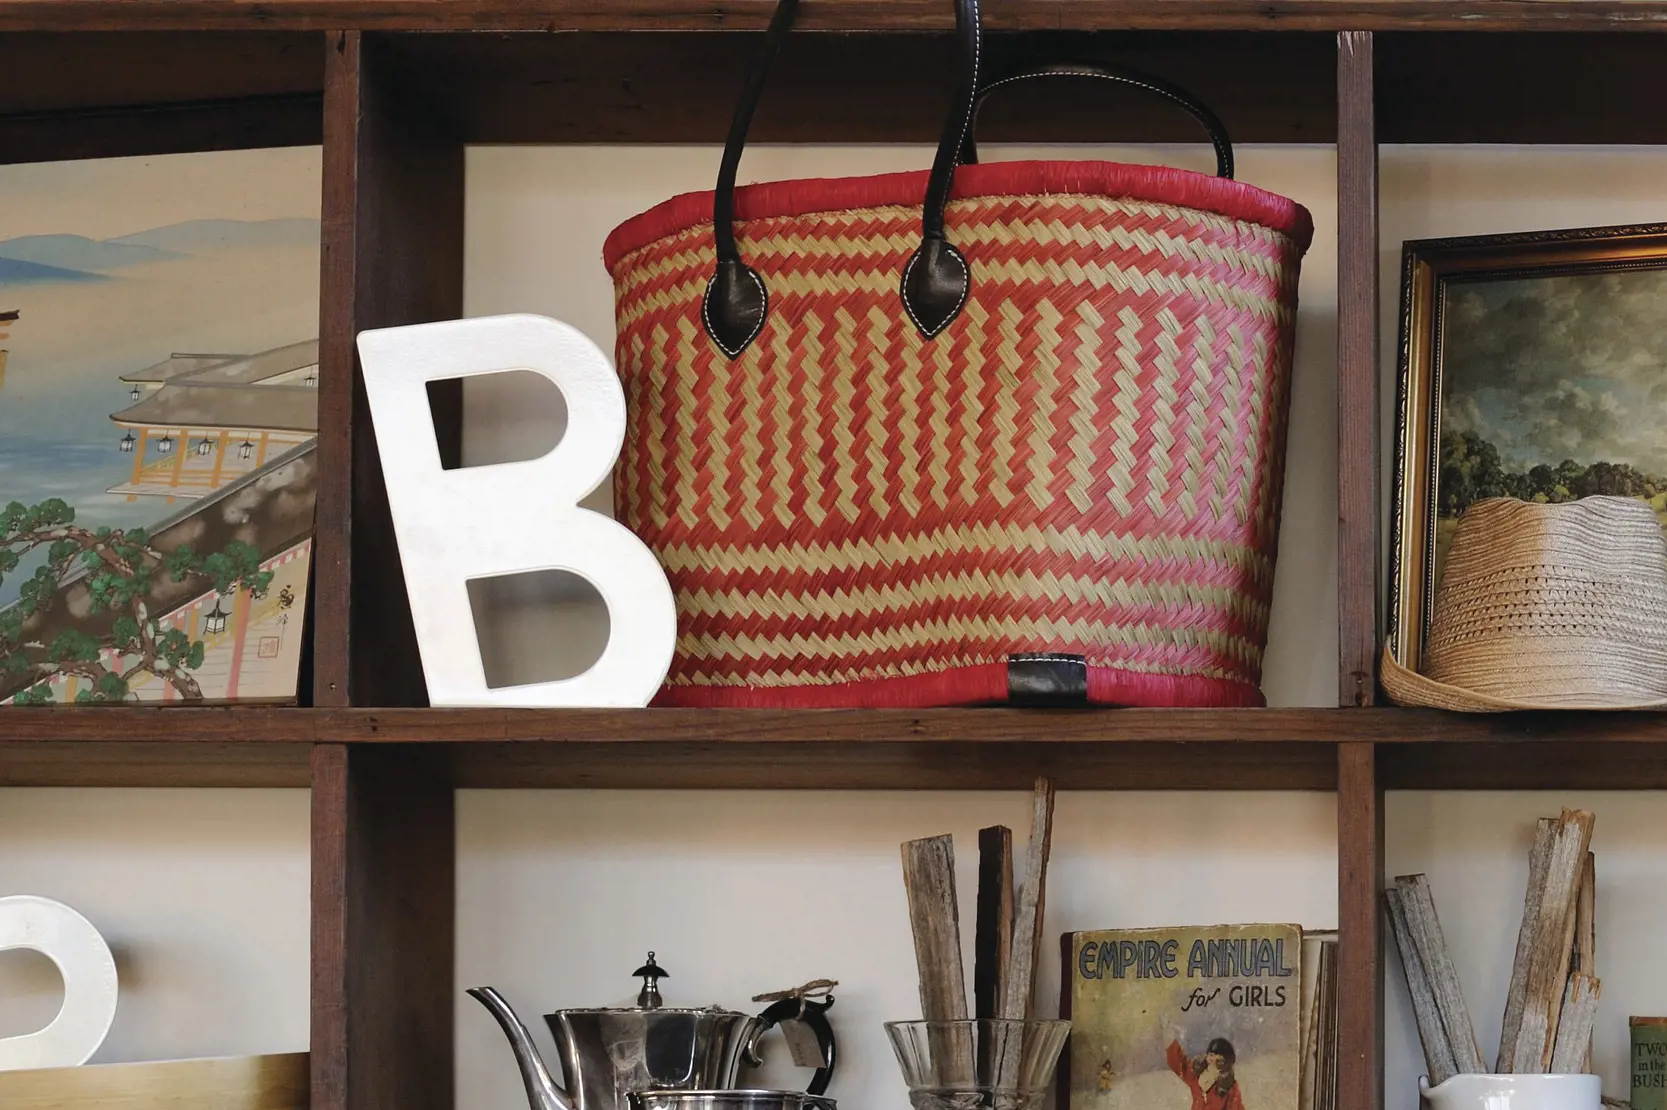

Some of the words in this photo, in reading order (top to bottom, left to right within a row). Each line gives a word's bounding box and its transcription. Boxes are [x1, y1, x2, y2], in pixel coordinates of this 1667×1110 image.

[357, 313, 677, 708] B
[1079, 939, 1179, 979] EMPIRE
[1188, 938, 1293, 978] ANNUAL
[1181, 987, 1221, 1012] for
[1228, 985, 1287, 1007] GIRLS
[1638, 1061, 1648, 1071] in
[1649, 1060, 1666, 1071] the
